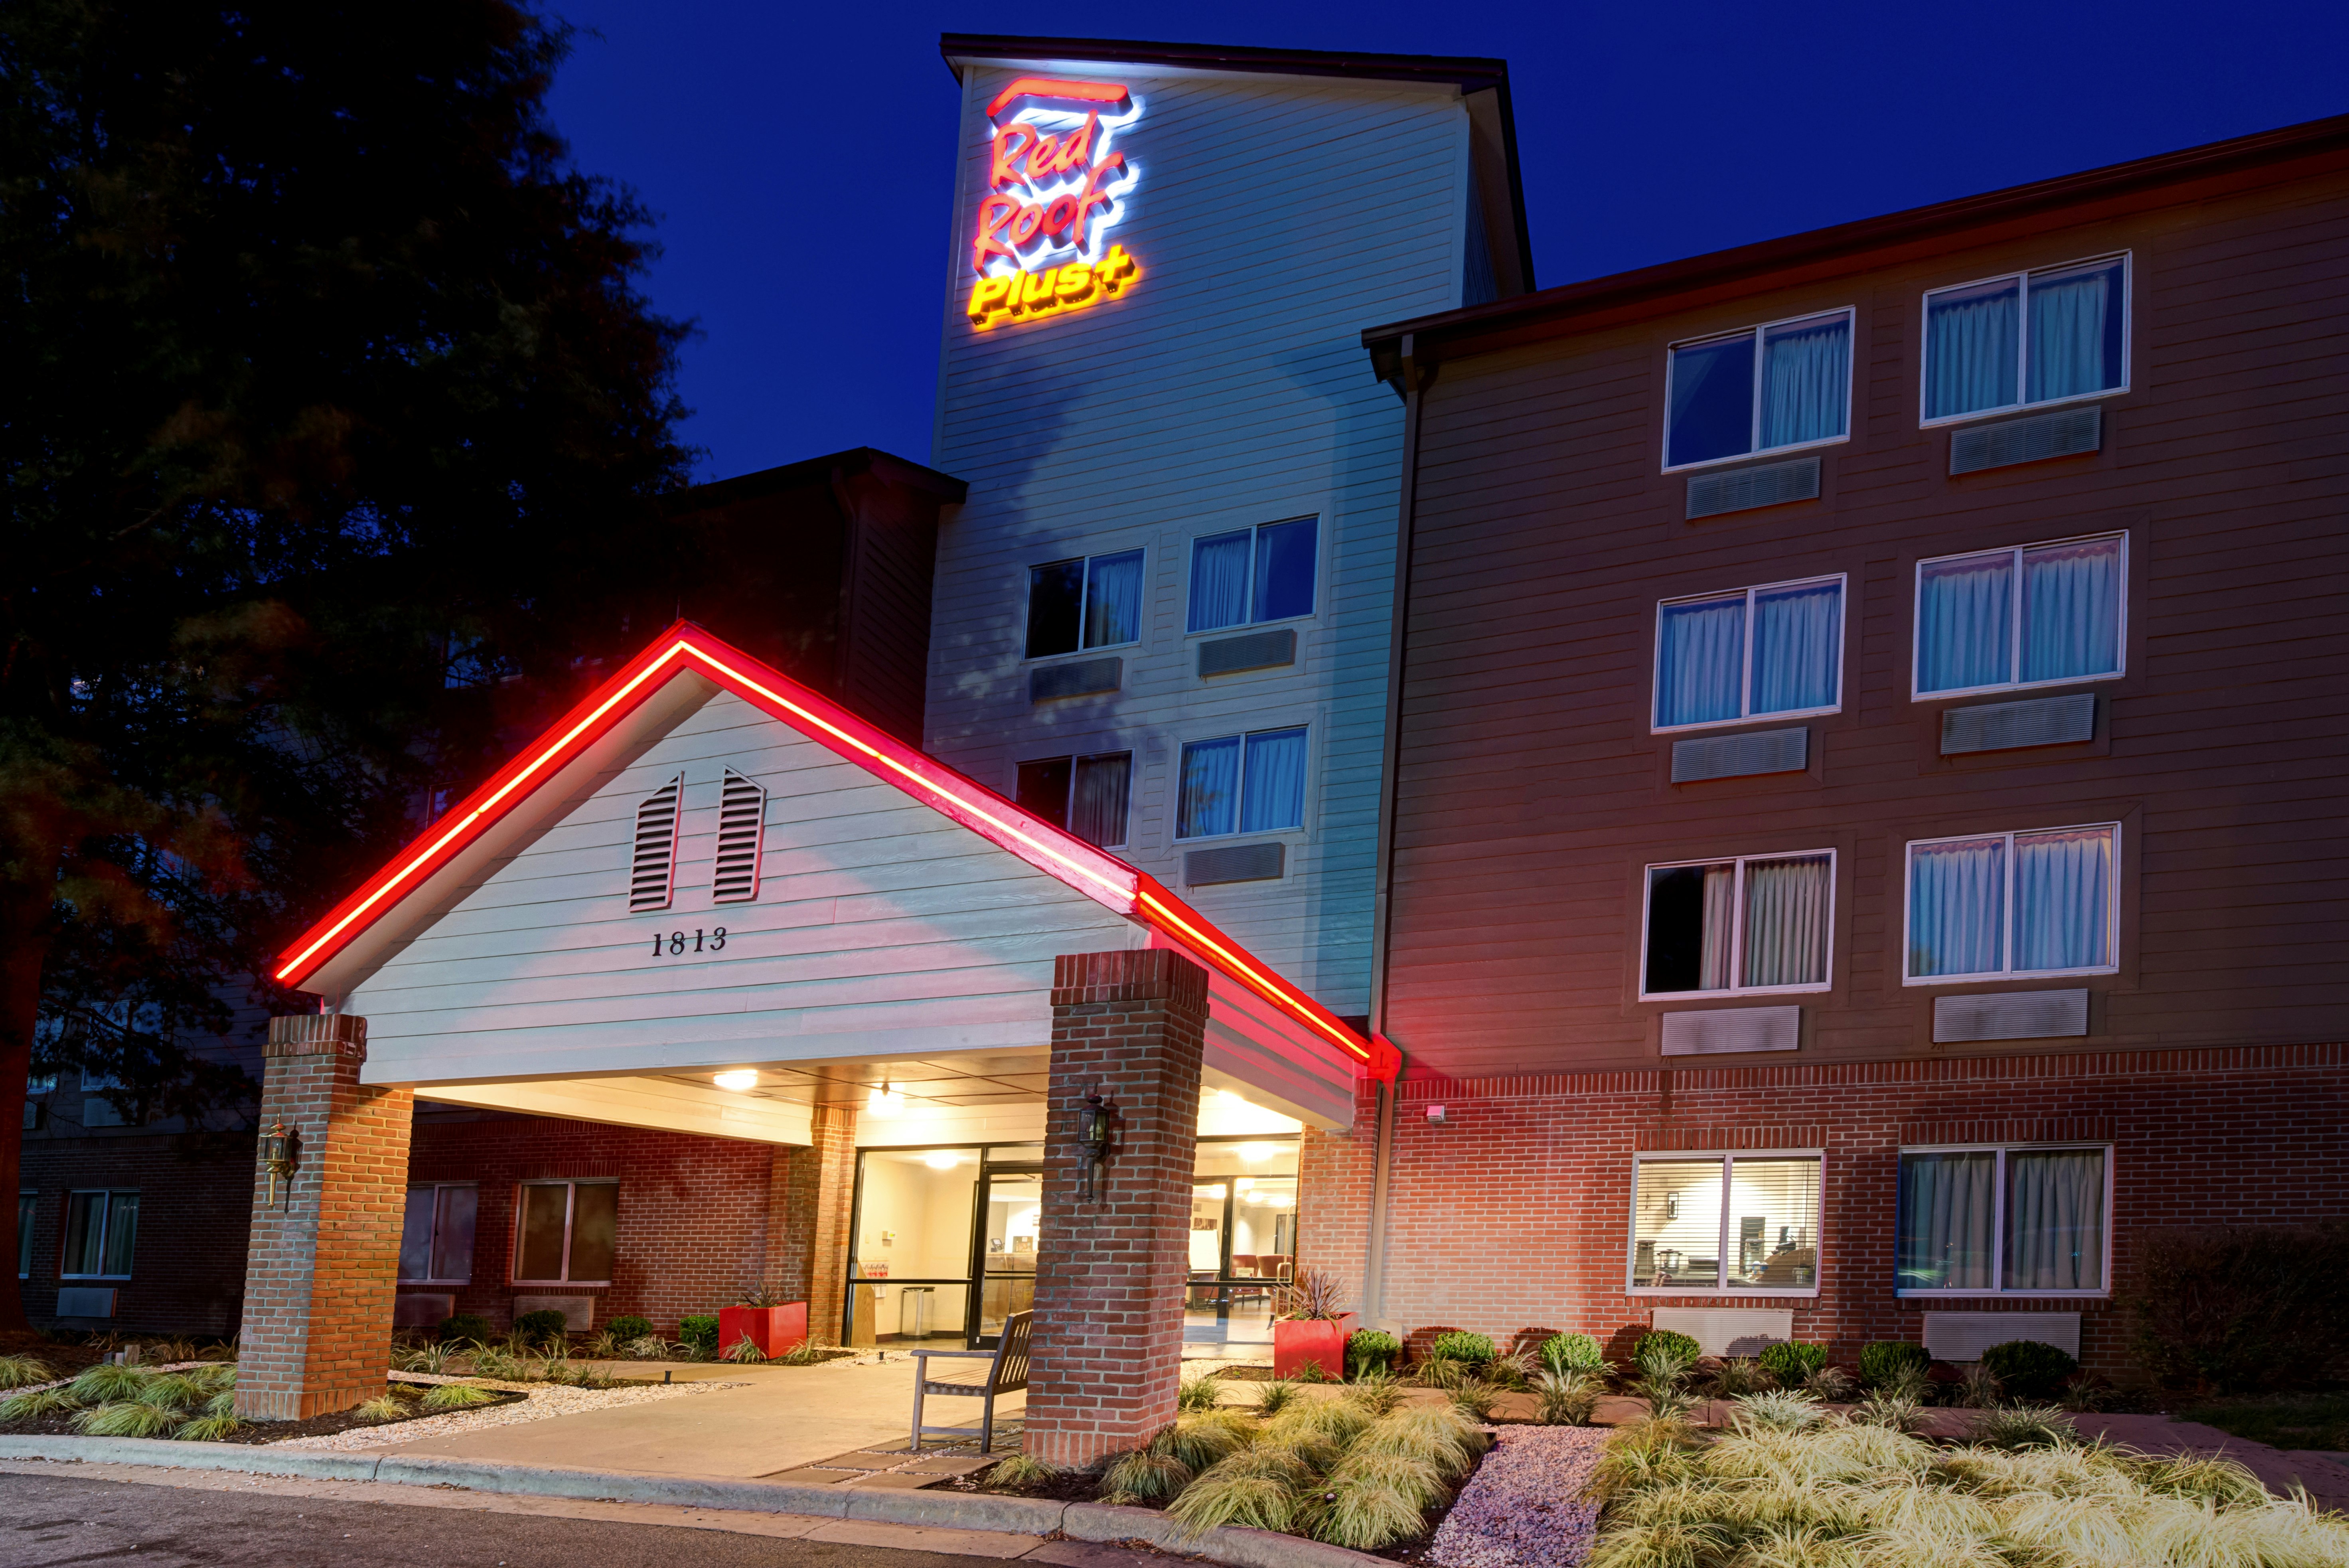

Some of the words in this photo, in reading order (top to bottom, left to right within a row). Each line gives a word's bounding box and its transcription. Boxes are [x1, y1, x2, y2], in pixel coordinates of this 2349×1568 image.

[990, 110, 1098, 189] Red
[973, 152, 1123, 271] Roof
[652, 927, 726, 956] 1813
